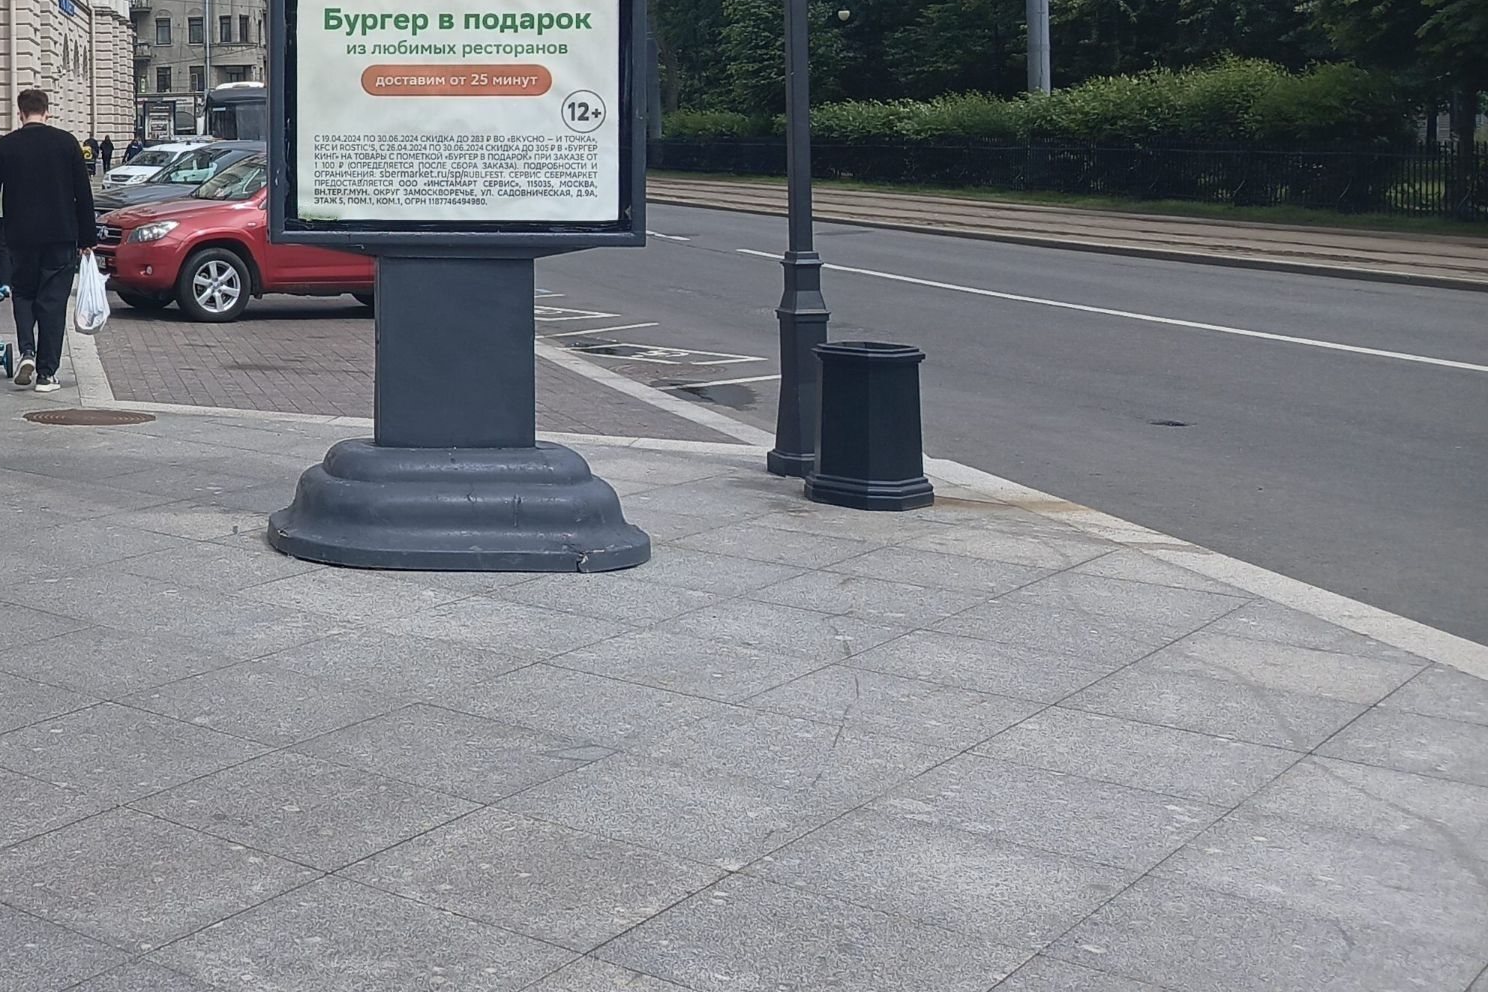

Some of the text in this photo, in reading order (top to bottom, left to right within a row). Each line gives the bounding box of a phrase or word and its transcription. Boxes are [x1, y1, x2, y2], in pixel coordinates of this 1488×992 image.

[323, 8, 593, 36] Бургер в подарок
[346, 40, 569, 58] из любимых ресторанов
[375, 74, 538, 87] доставим от 25 минут
[567, 102, 602, 122] 12+
[420, 135, 454, 143] СКИДКА
[456, 135, 469, 143] ДО
[485, 144, 520, 152] СКИДКА
[527, 180, 554, 188] 115035,
[559, 180, 598, 188] МОСКВА,
[403, 189, 477, 197] ЗАМОСКВОРЕЧЬЕ,
[497, 189, 573, 197] САДОВНИЧЕСКАЯ,
